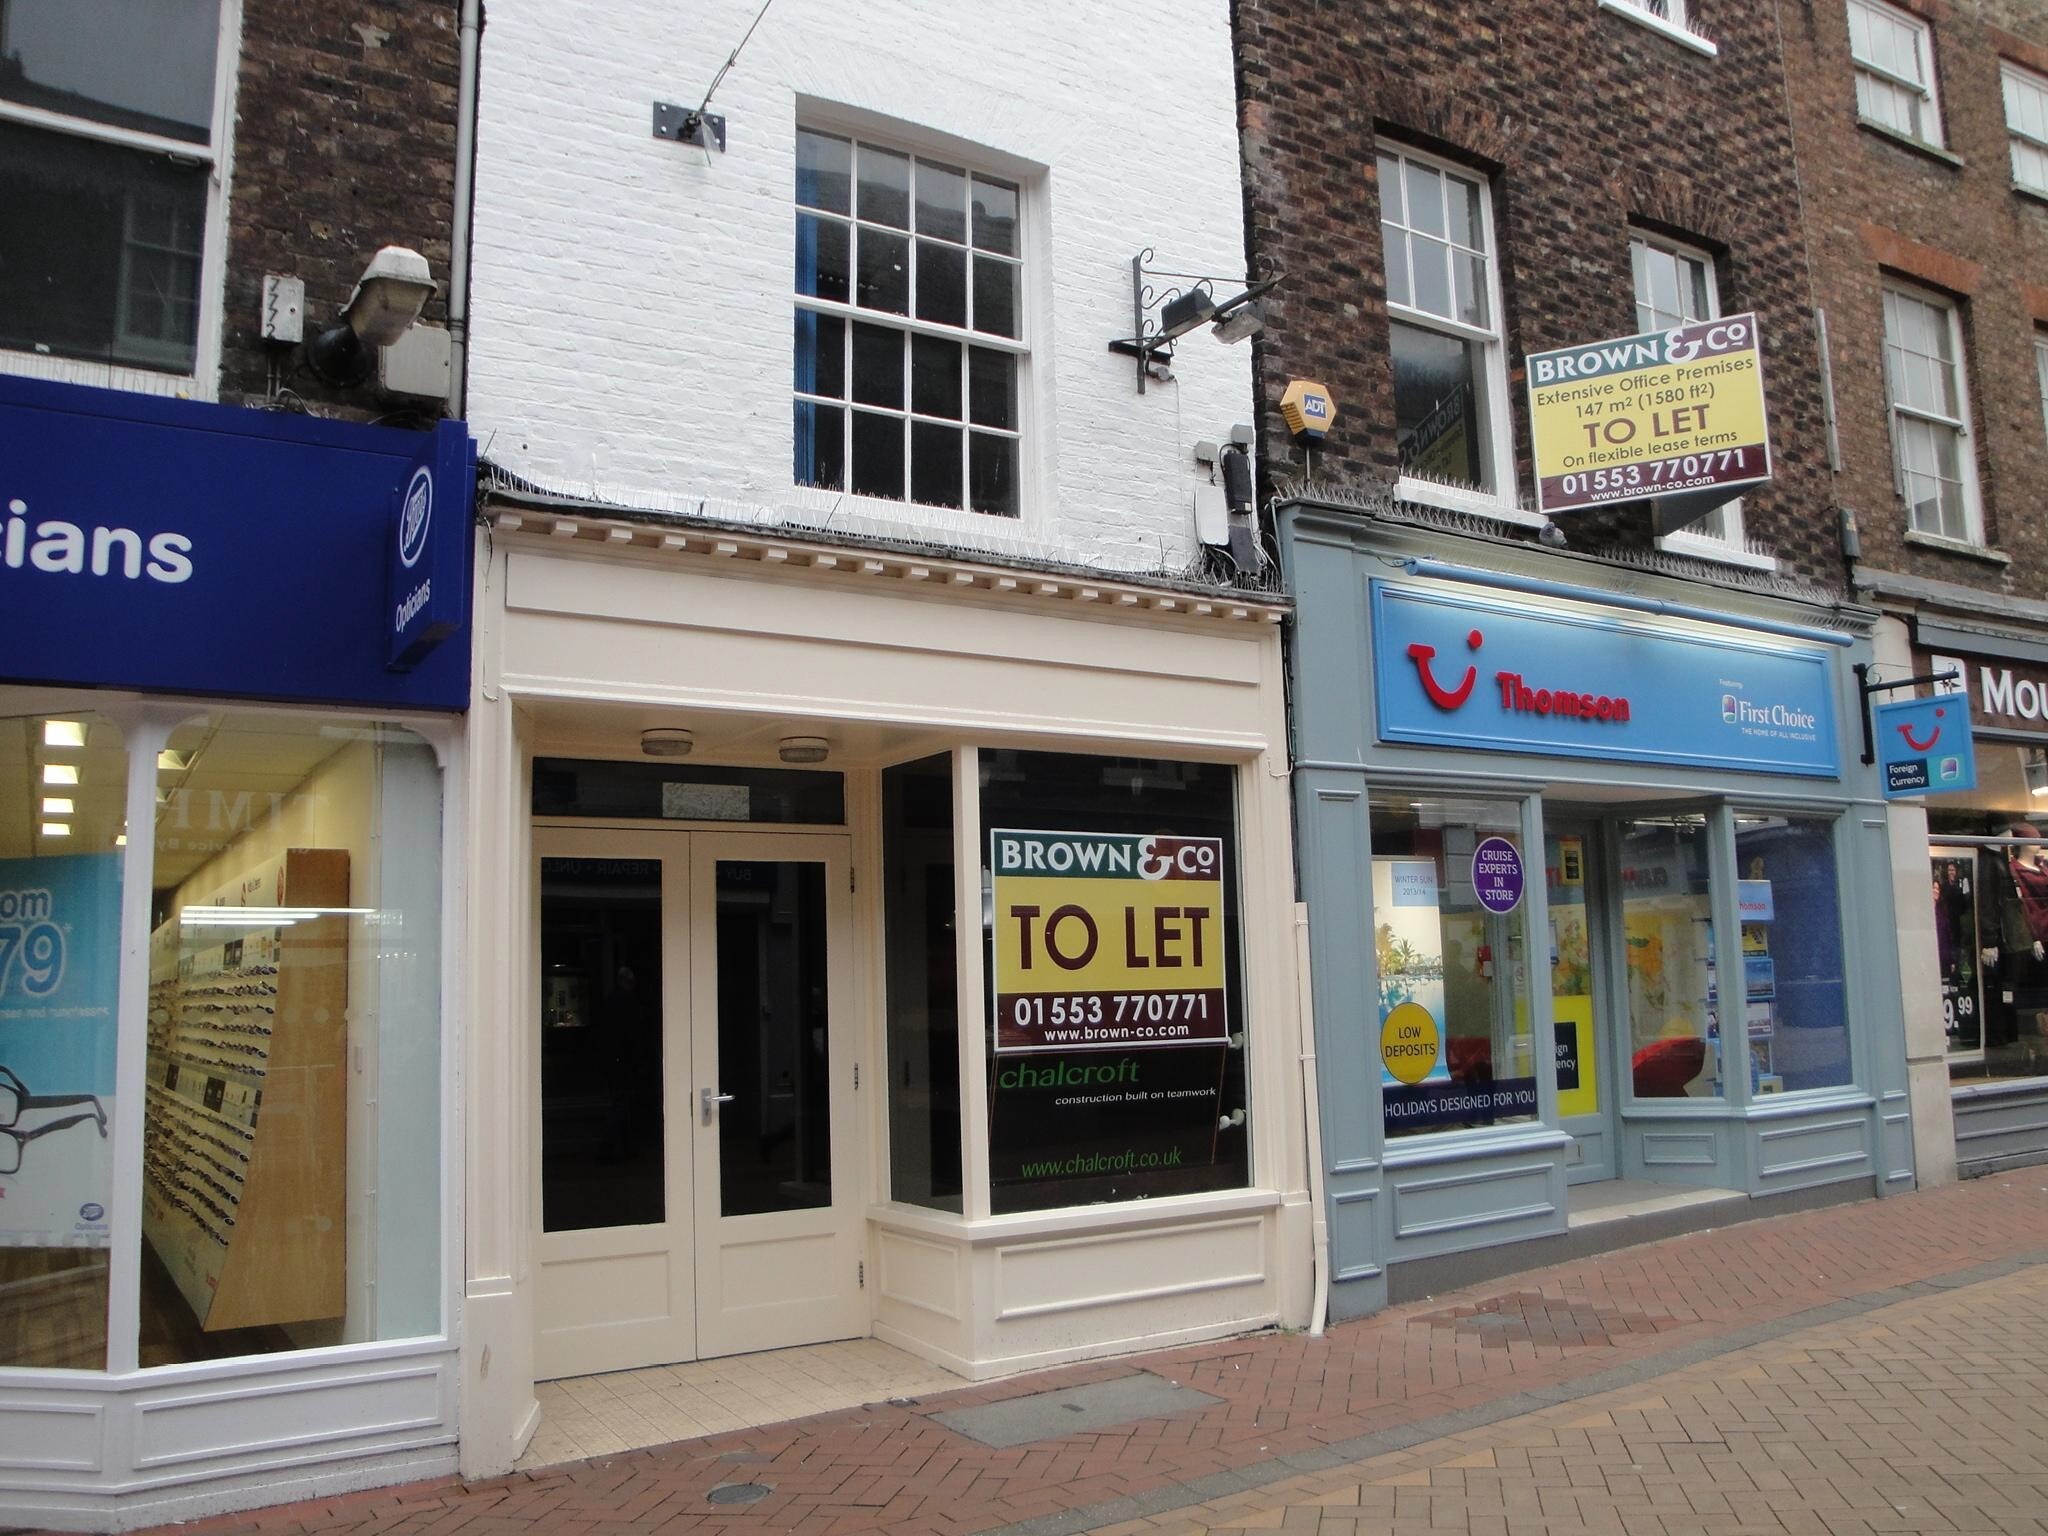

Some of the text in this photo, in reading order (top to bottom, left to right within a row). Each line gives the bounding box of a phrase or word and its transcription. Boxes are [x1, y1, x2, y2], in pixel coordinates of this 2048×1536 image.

[1535, 340, 1659, 383] BROWN
[1664, 329, 1702, 364] &
[1537, 357, 1754, 407] Extensive Office Premises
[1305, 399, 1326, 414] ADT
[1576, 402, 1603, 418] 147
[1638, 387, 1685, 410] (1580
[1583, 404, 1711, 448] TO LET
[1563, 430, 1738, 468] On flexible lease terms
[1562, 449, 1745, 495] 01553 770771
[1590, 474, 1715, 501] www.brown-co.com
[0, 498, 194, 583] ians
[396, 578, 431, 633] Opticians
[1496, 671, 1631, 722] Thomson
[1739, 700, 1815, 729] First Choice
[1742, 727, 1752, 735] THE
[1889, 764, 1918, 774] Foreign
[1890, 775, 1925, 787] Currency
[1001, 839, 1131, 872] BROWN
[1137, 836, 1174, 881] &
[1478, 863, 1518, 875] EXPERTS
[1481, 850, 1513, 861] CRUISE
[1394, 875, 1418, 884] WINTER
[1493, 877, 1504, 888] IN
[1485, 890, 1514, 901] STORE
[1010, 904, 1209, 970] TO LET
[1014, 993, 1207, 1026] 01553 770771
[1044, 1023, 1189, 1041] www.brown-co.com
[1398, 1027, 1421, 1039] LOW
[1385, 1043, 1436, 1057] DEPOSITS
[999, 1058, 1141, 1089] chalcroft
[1055, 1086, 1216, 1105] construction built on teamwork
[1385, 1090, 1536, 1118] HOLIDAYS DESIGNED FOR YOU
[1021, 1145, 1182, 1178] www.chalcroft.co.uk
